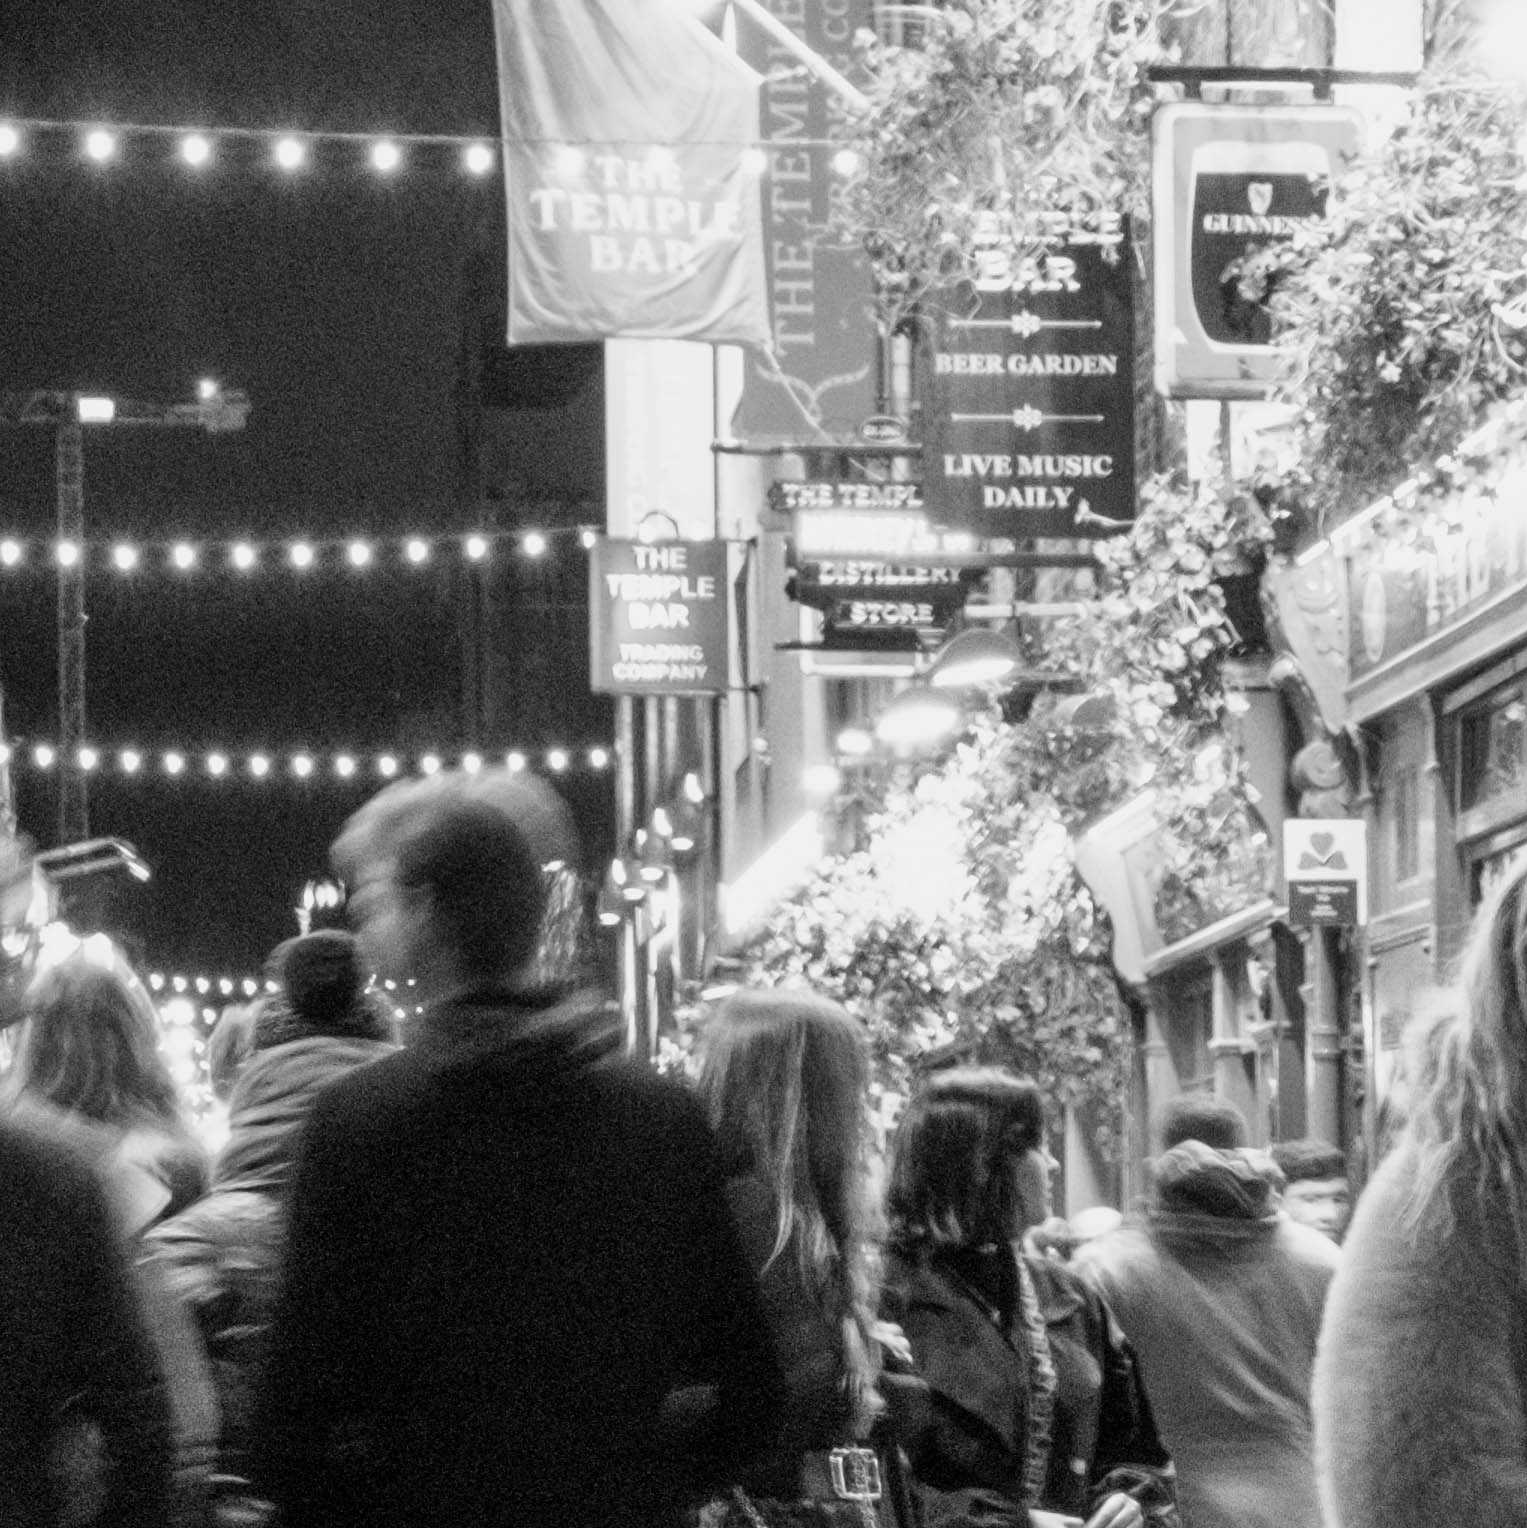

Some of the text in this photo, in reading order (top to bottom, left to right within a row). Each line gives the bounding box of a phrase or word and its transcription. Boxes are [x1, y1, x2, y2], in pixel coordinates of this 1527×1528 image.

[529, 188, 746, 241] TEMPLE
[590, 235, 699, 274] BAR
[974, 251, 1081, 292] BAR
[773, 240, 814, 356] THE
[934, 353, 1118, 377] BEER GARDEN
[944, 454, 1114, 478] LIVE MUSIC
[782, 483, 924, 508] THE TEMPL
[983, 485, 1074, 509] DAILY
[632, 545, 688, 571] THE
[606, 573, 716, 601] TEMPLE
[628, 602, 691, 630] BAR
[851, 602, 934, 625] STORE
